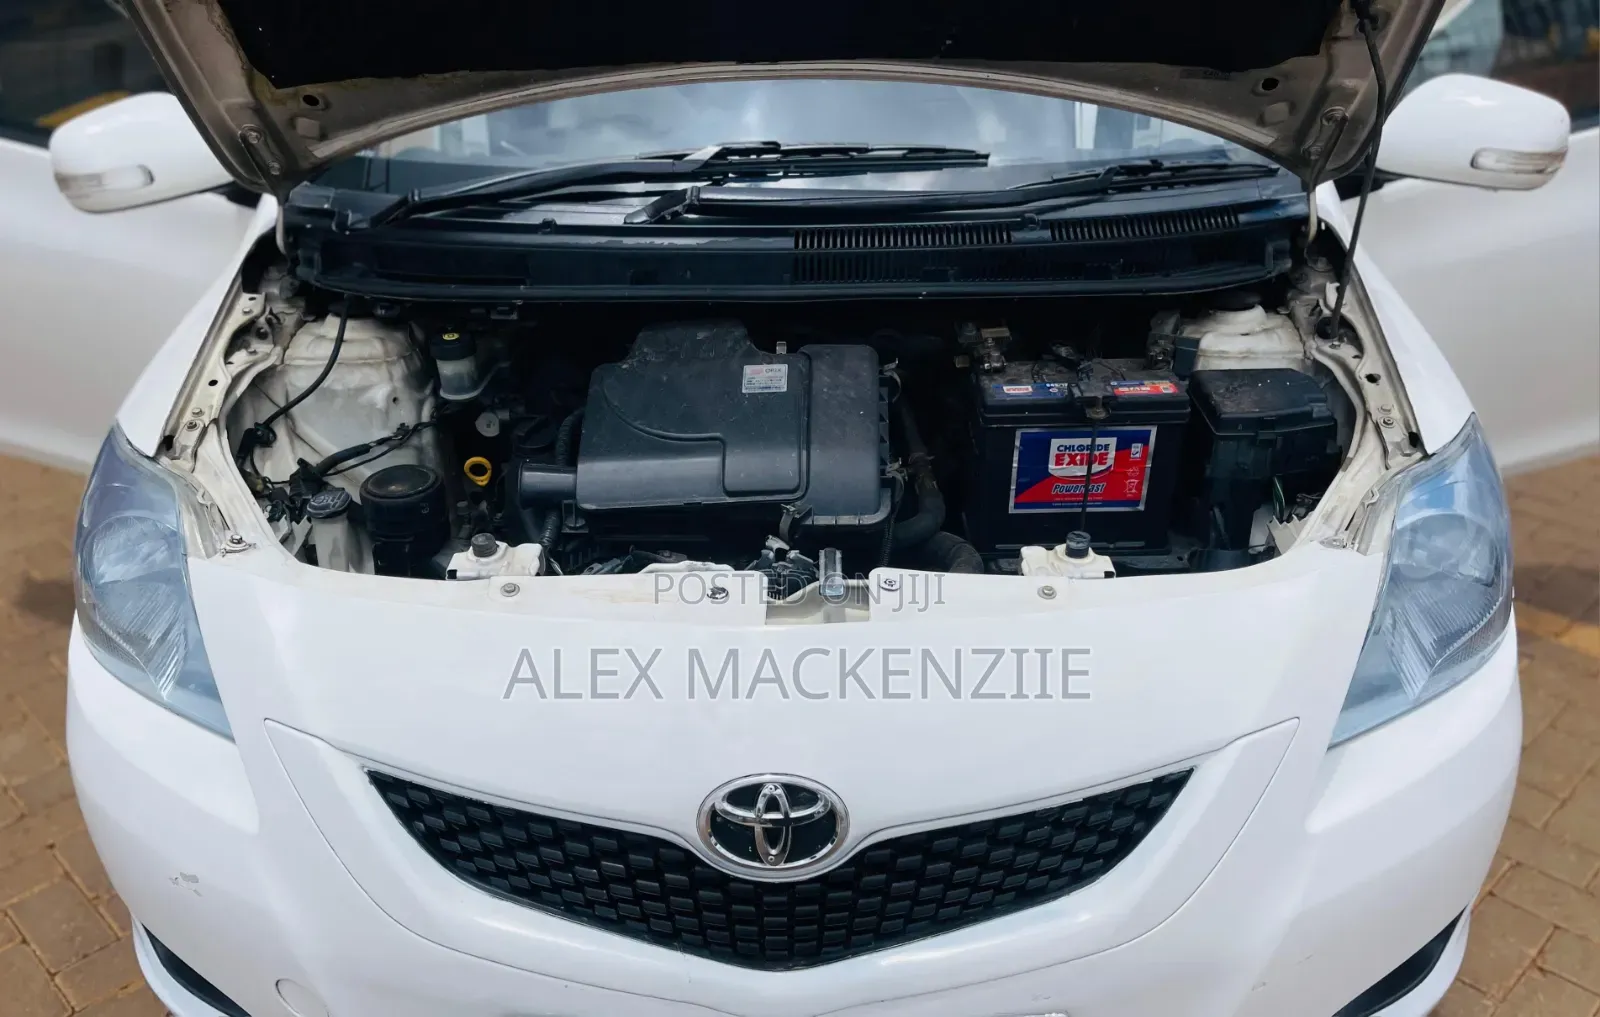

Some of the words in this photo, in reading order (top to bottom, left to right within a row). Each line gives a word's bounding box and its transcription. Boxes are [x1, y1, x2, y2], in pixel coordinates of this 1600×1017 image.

[1056, 443, 1110, 452] CHLORDE
[1054, 452, 1109, 467] EXIDE
[1051, 482, 1106, 495] Powerast
